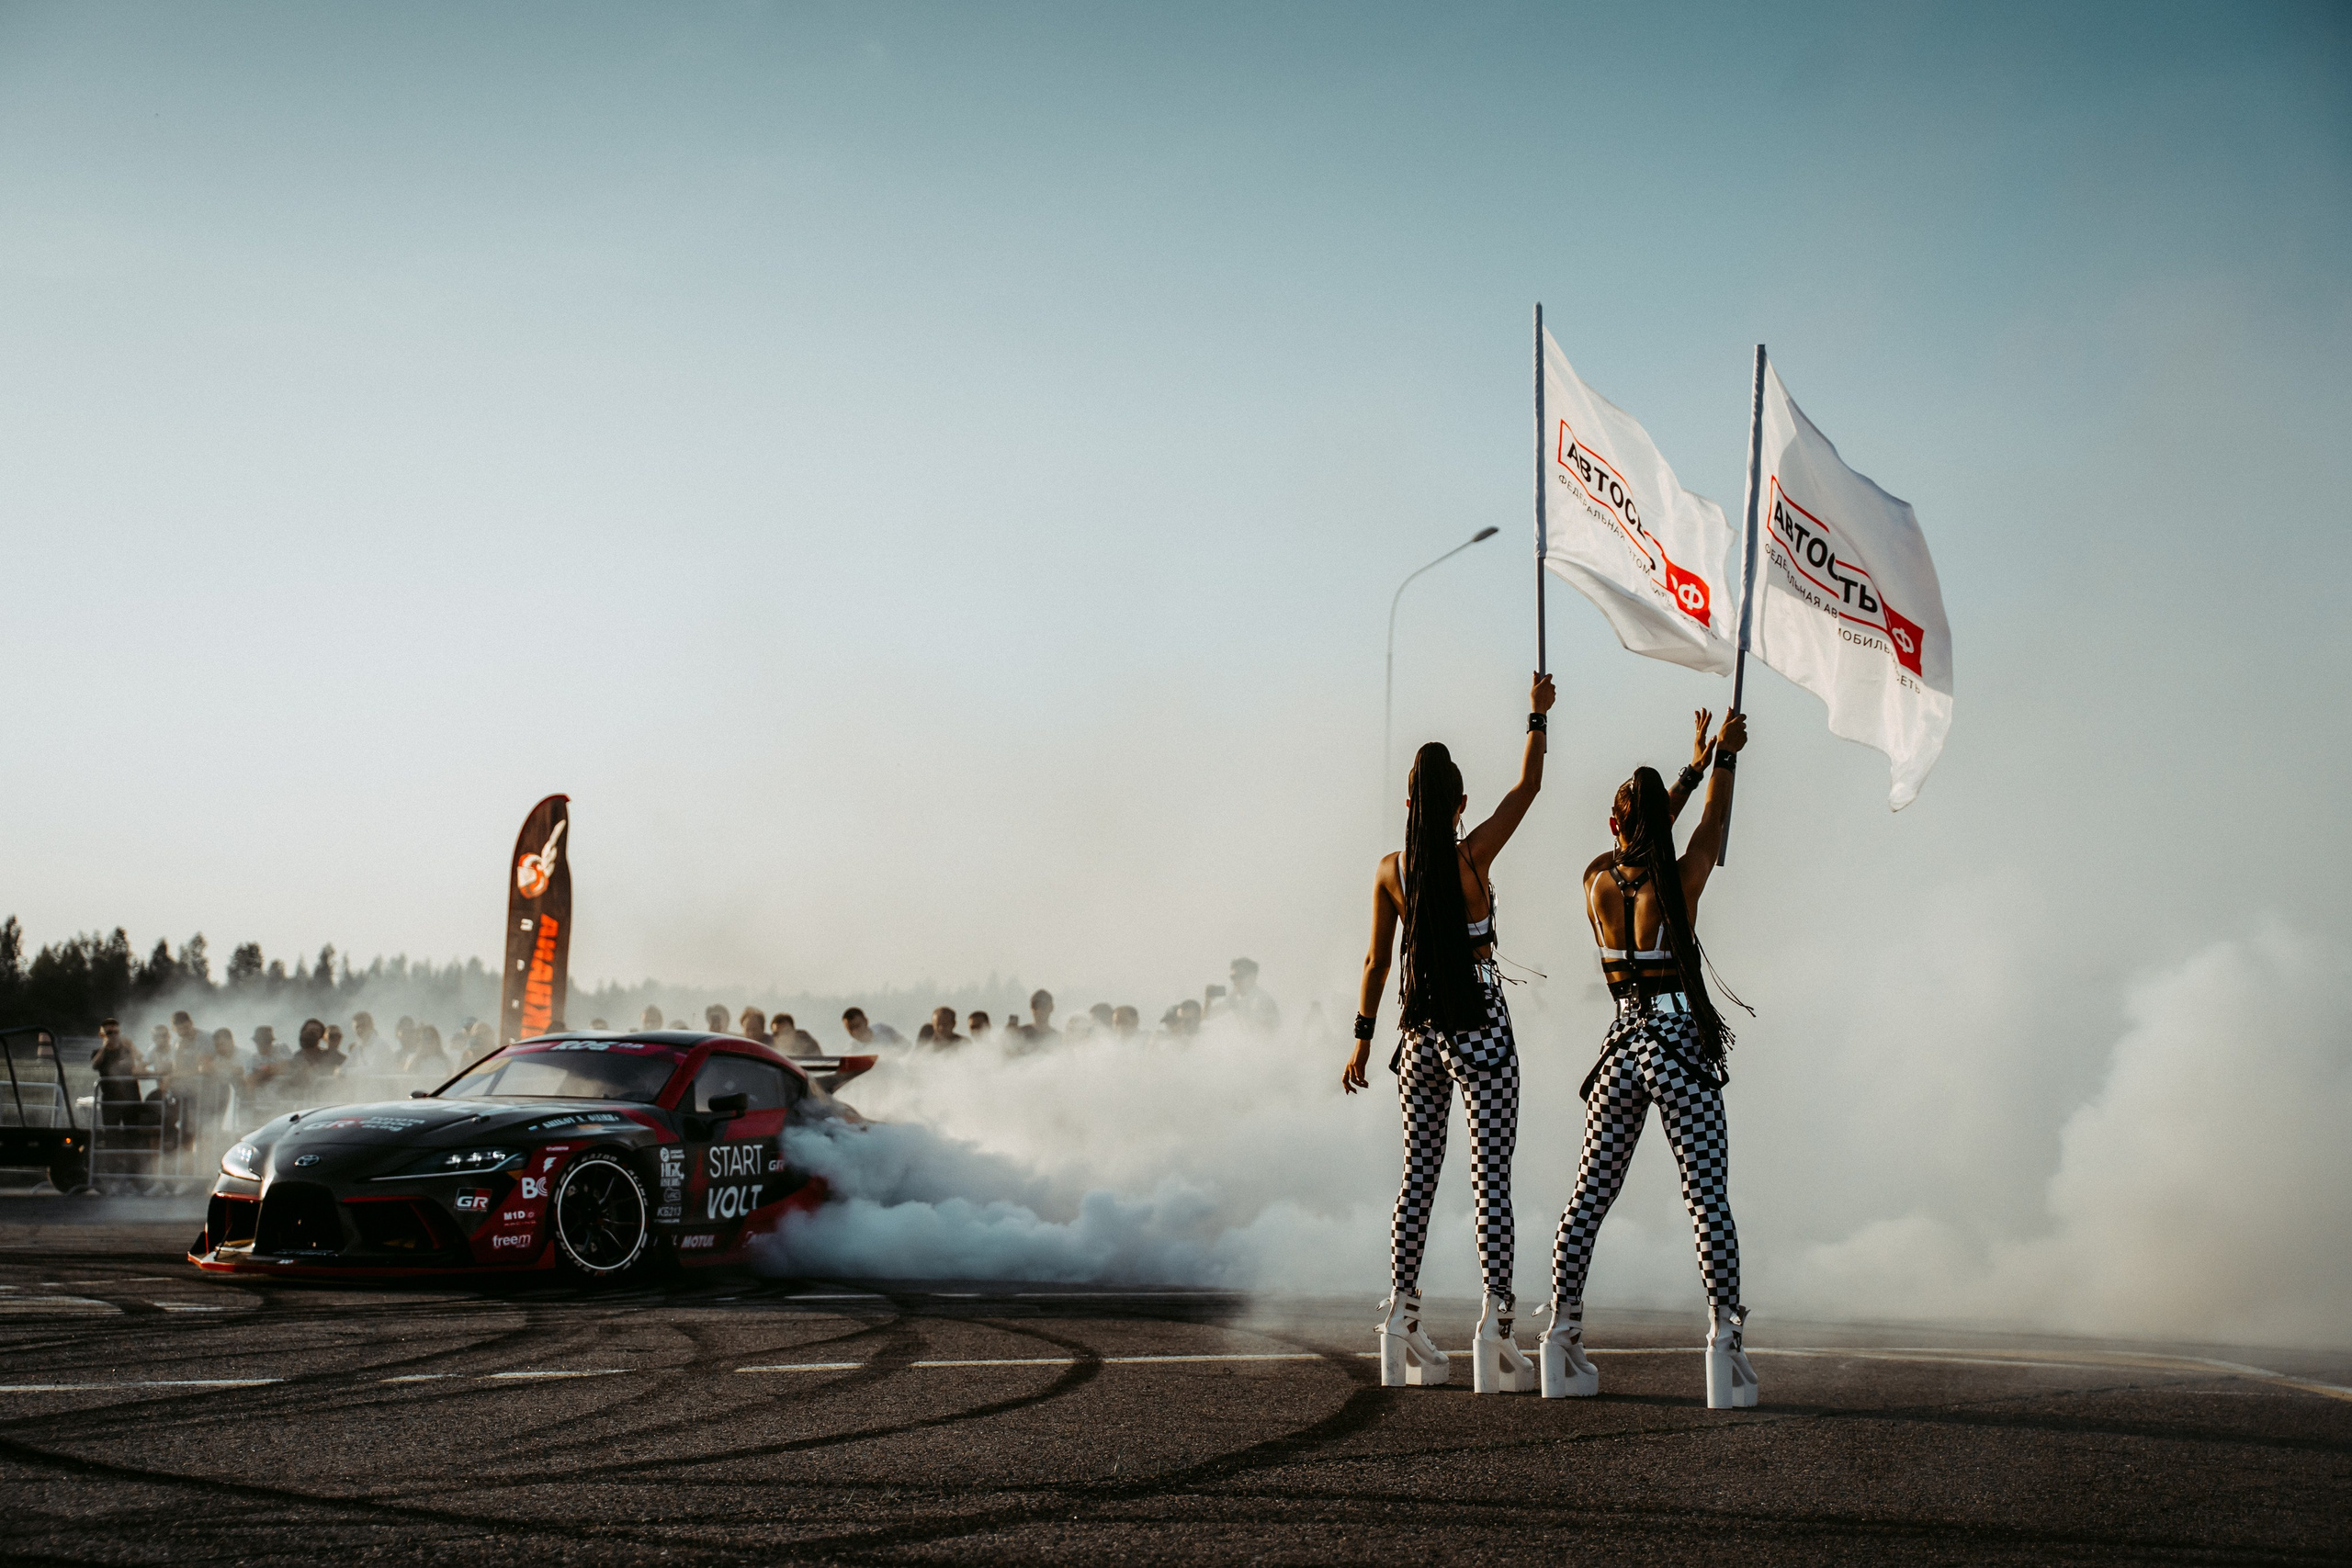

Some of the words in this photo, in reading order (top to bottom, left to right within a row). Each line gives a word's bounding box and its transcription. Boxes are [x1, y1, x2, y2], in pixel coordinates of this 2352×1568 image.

[1774, 500, 1879, 614] АВТОСТЬ
[1765, 543, 1821, 608] ФЕДЕЛЬНАЯ
[709, 1145, 763, 1178] START
[457, 1196, 489, 1208] GR
[707, 1185, 763, 1219] VOLT
